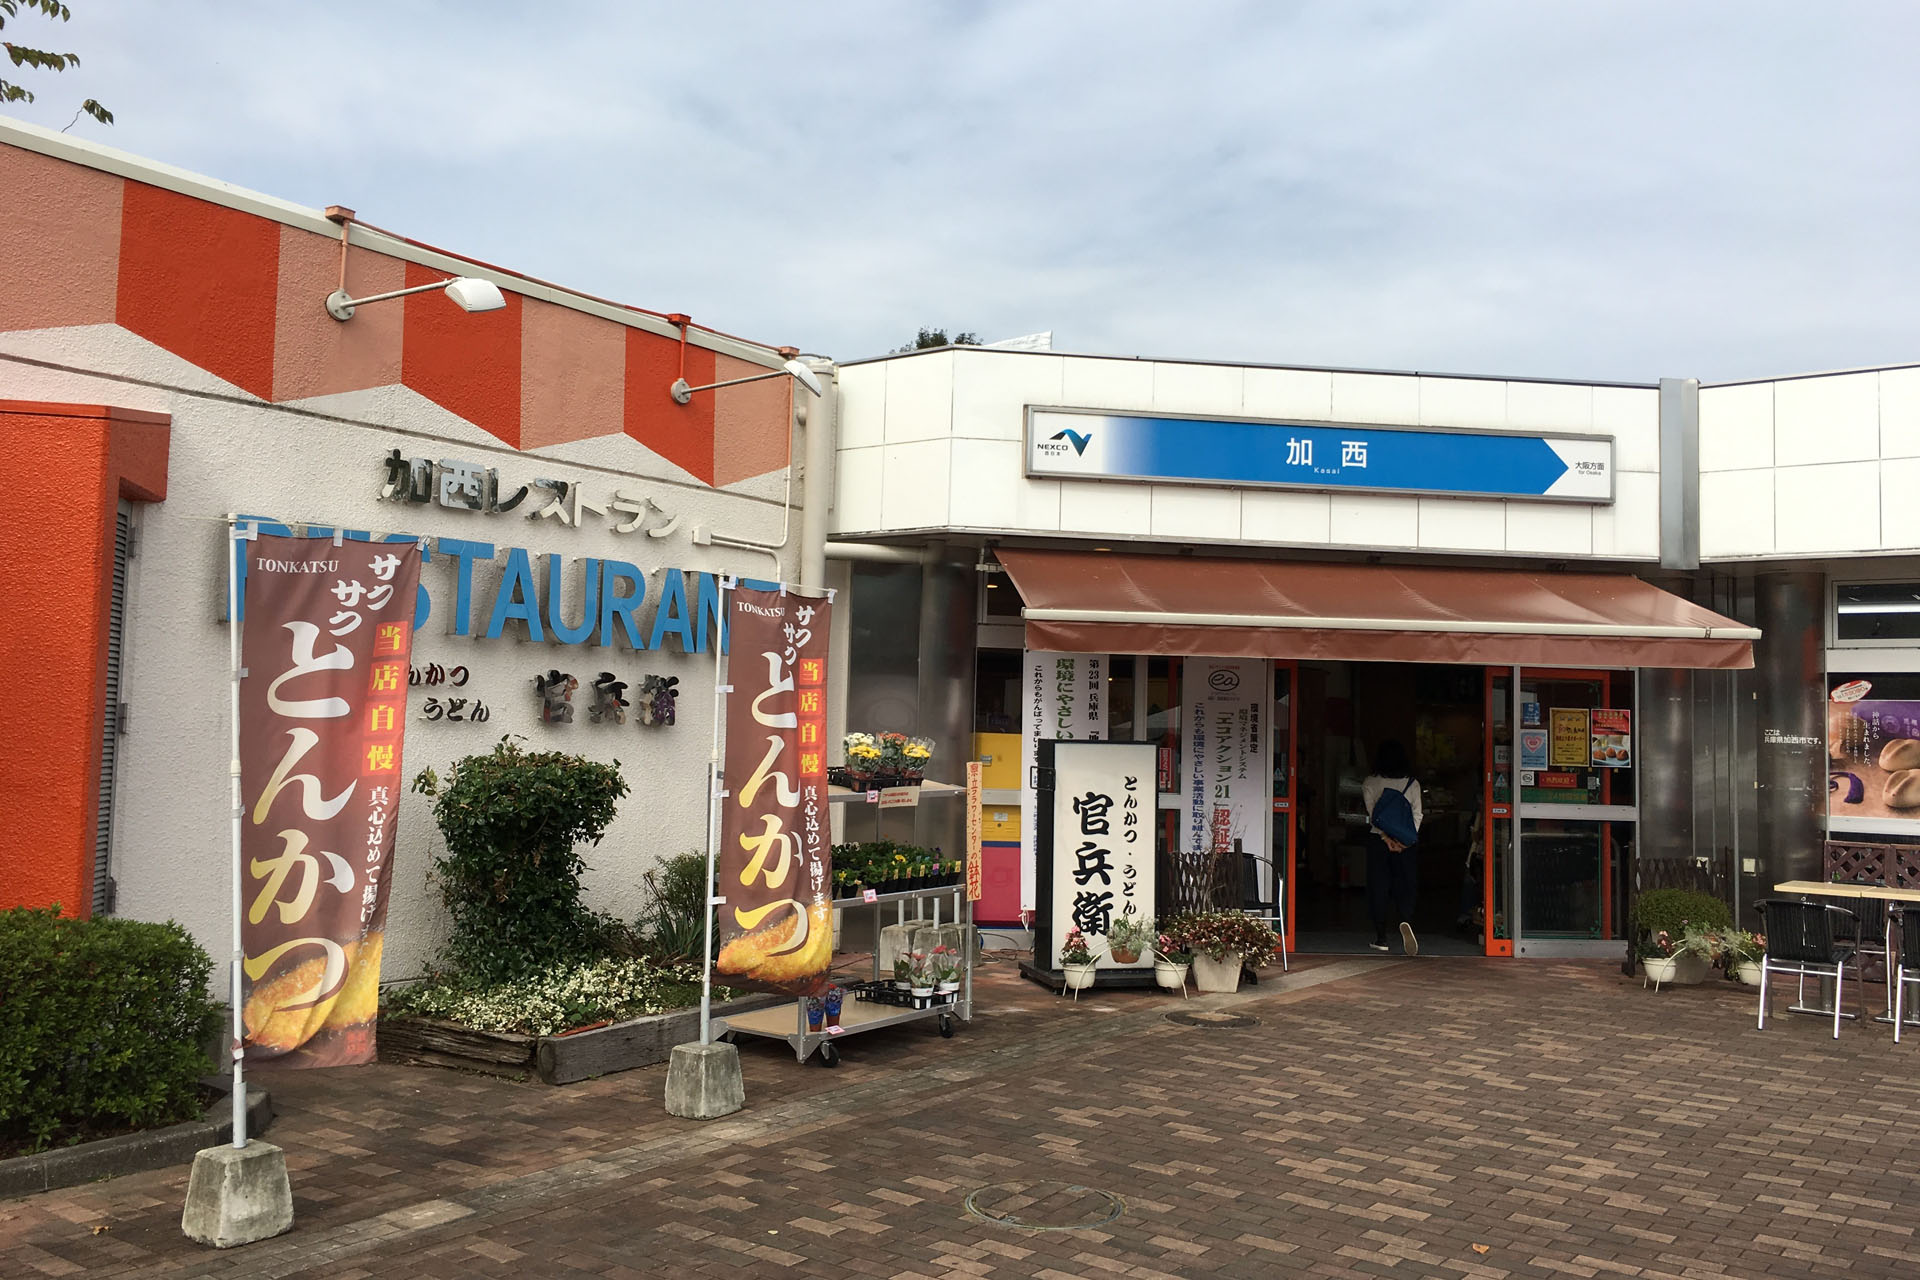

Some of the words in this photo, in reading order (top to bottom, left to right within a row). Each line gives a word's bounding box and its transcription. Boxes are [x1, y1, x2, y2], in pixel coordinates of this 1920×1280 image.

[1037, 443, 1069, 451] NEXCO
[1286, 437, 1368, 468] 加西
[1575, 461, 1605, 470] 大阪方面
[1313, 466, 1341, 475] Kasai
[380, 448, 679, 538] 加西レストラン
[256, 557, 340, 573] TONKATSU
[366, 553, 402, 611] サク
[328, 579, 367, 637] サク
[737, 601, 786, 618] TONKATSU
[794, 604, 815, 648] サク
[783, 622, 798, 666] サク
[366, 625, 402, 771] 当店自慢
[423, 697, 490, 722] うどん
[799, 661, 820, 774] 当店自慢
[1055, 658, 1075, 740] 環境にやさしい
[1088, 693, 1099, 721] 兵庫県
[1871, 711, 1880, 740] 神話から
[243, 620, 358, 1011] とんかつ
[734, 651, 810, 957] とんかつ
[1072, 791, 1115, 936] 官兵衛
[1122, 775, 1138, 915] とんかつ・うどん
